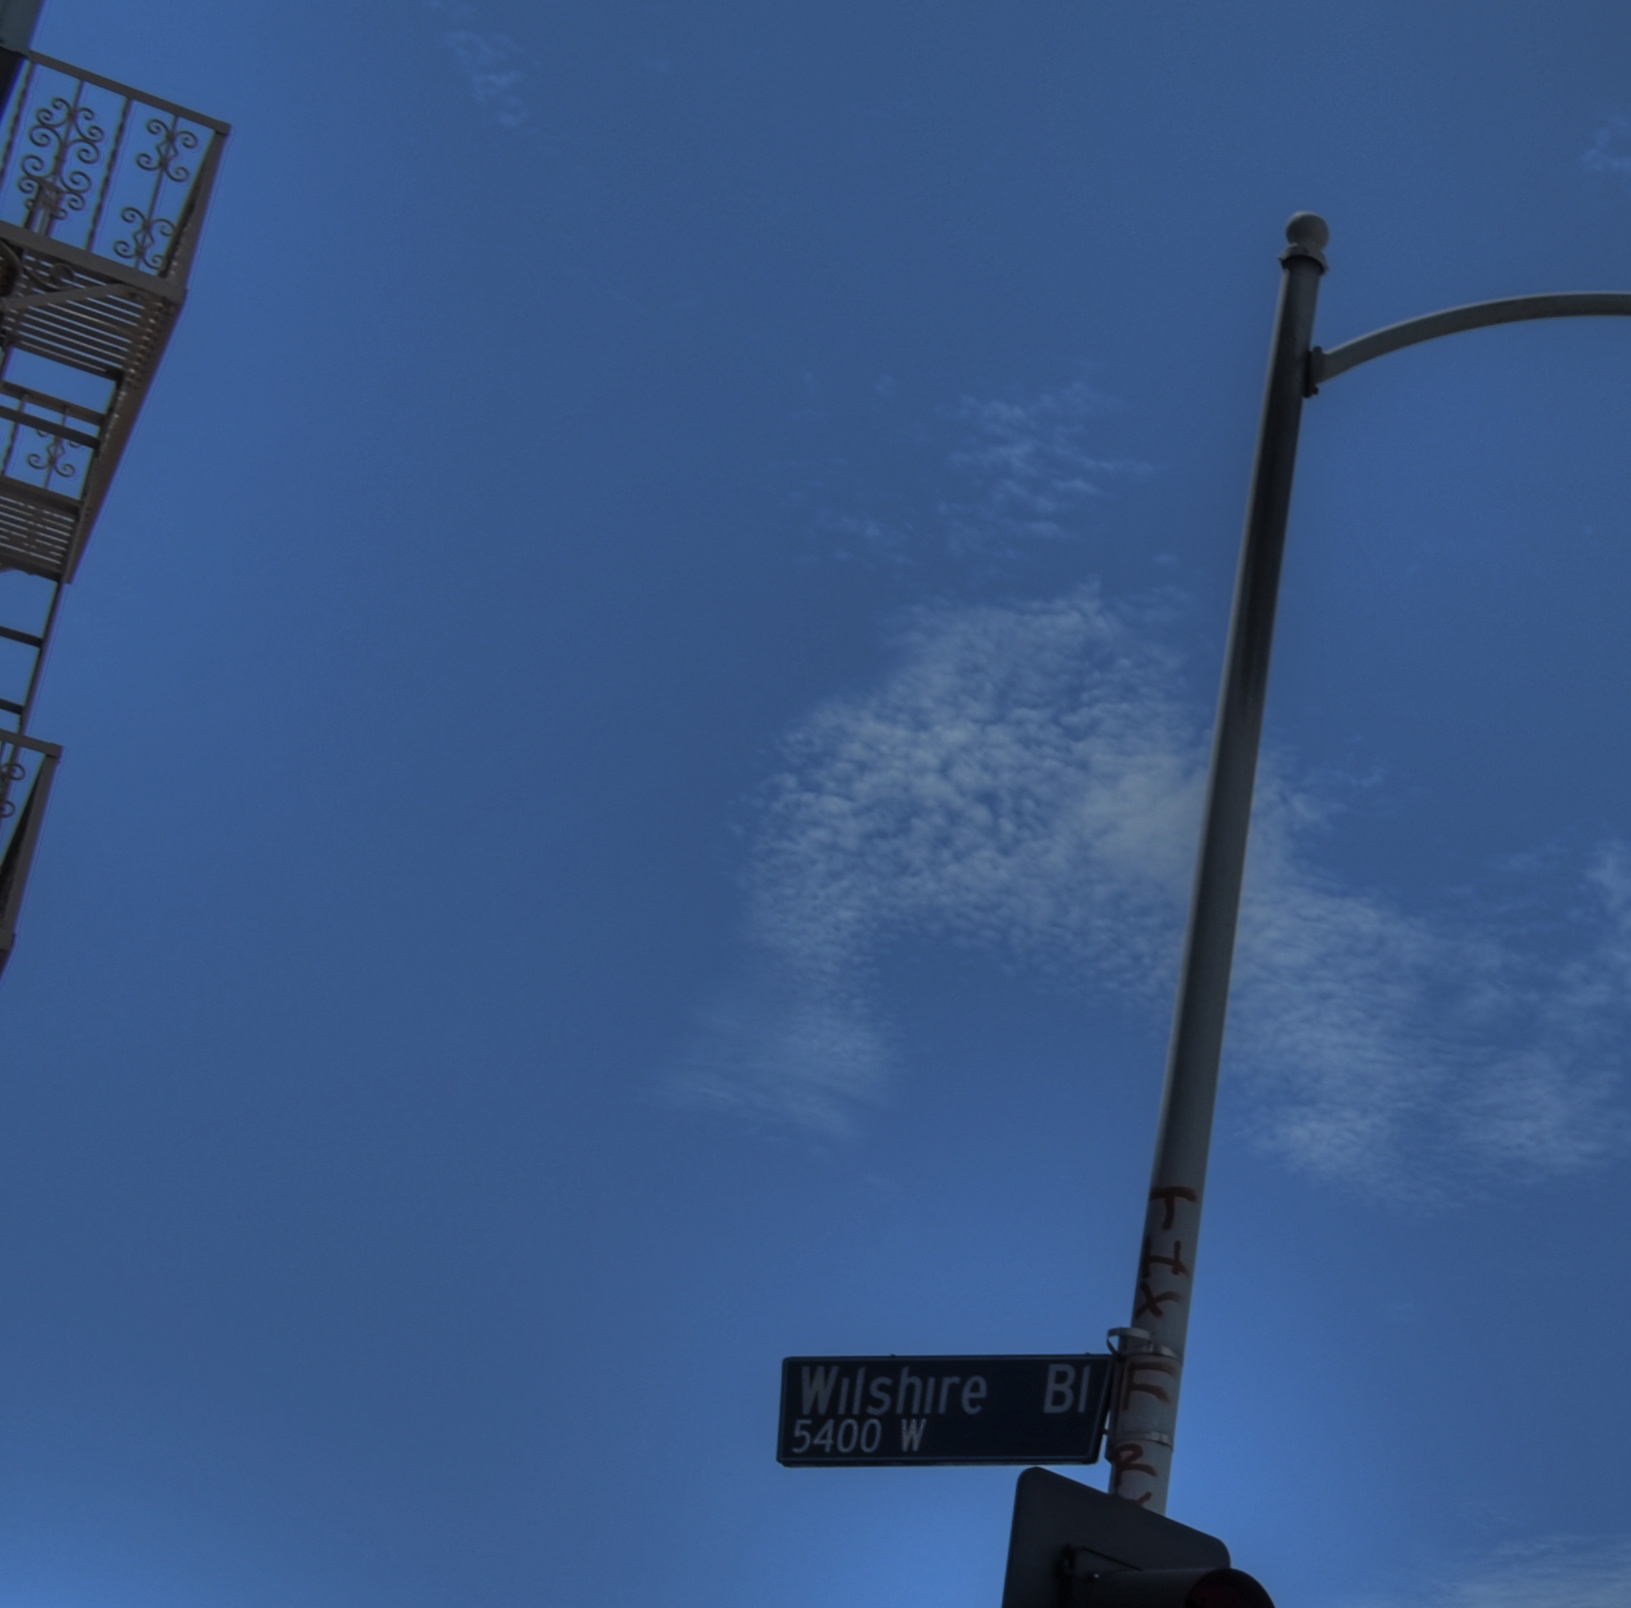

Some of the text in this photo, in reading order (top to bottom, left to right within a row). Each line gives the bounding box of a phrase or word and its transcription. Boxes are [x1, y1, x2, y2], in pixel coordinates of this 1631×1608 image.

[801, 1363, 1092, 1416] Wilshire Bl
[791, 1418, 927, 1454] 5400 W
